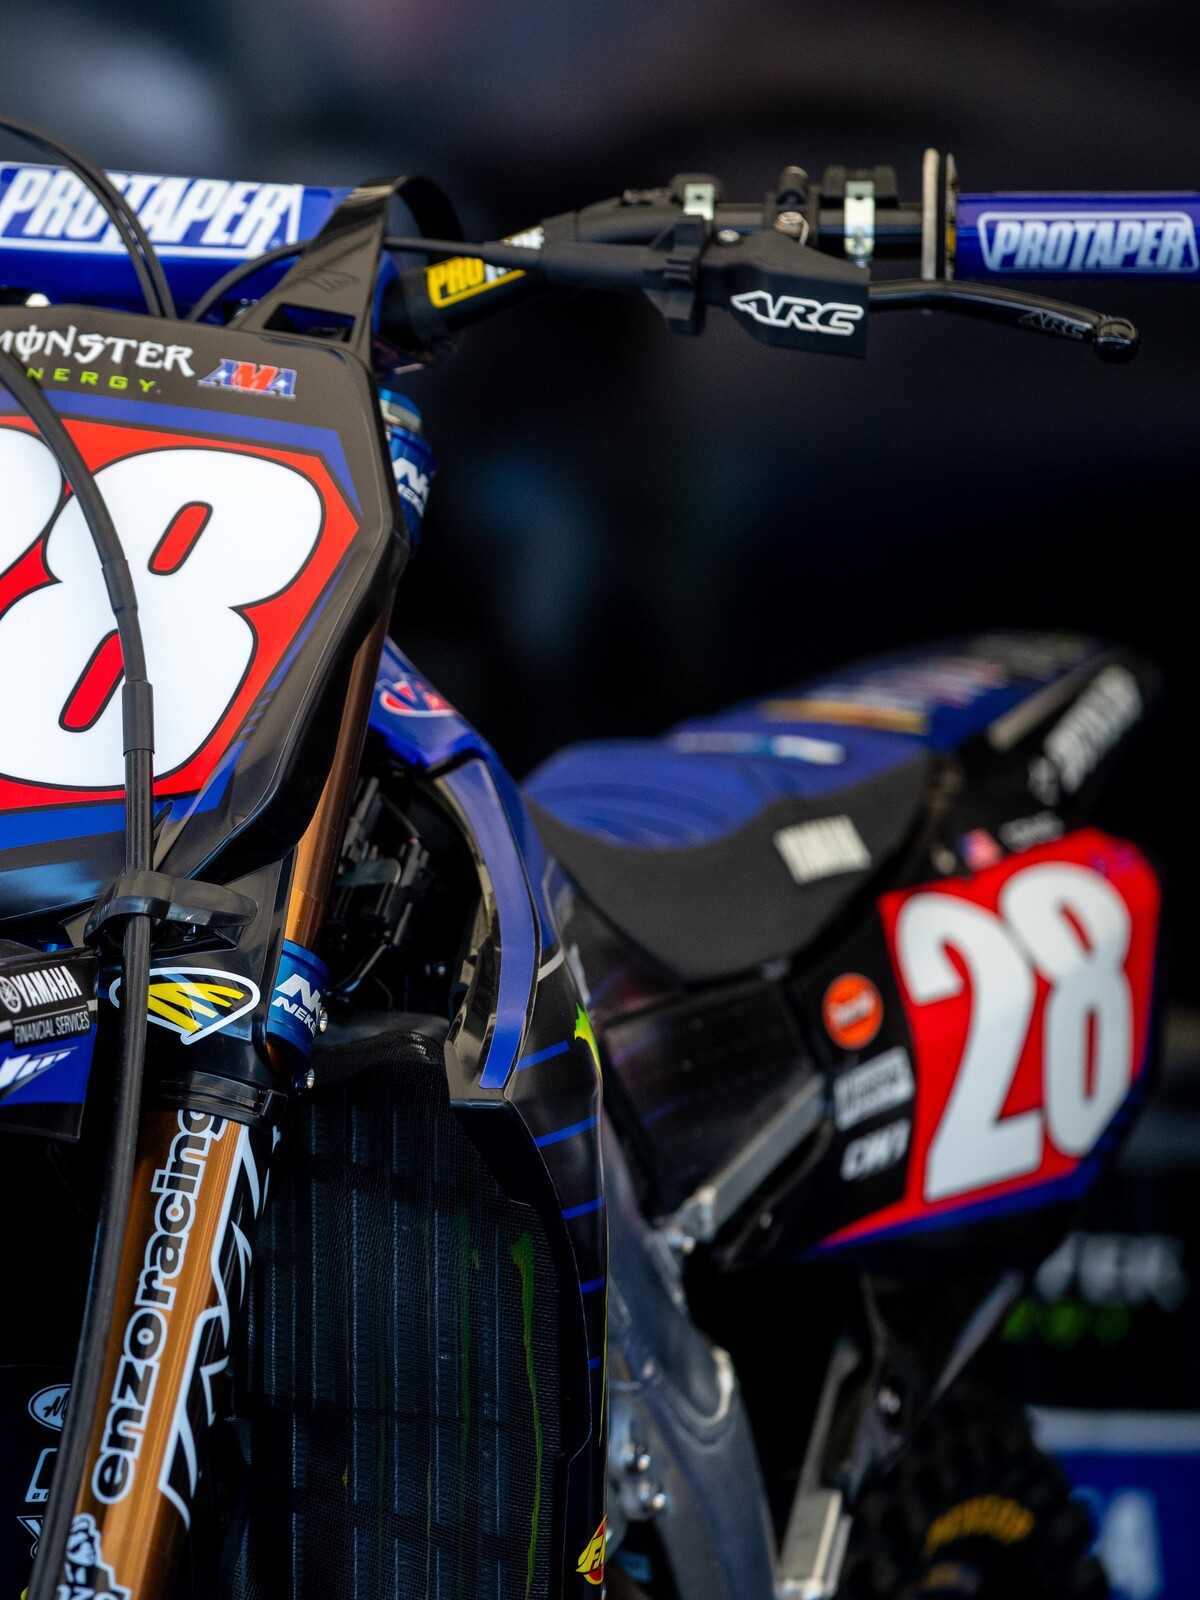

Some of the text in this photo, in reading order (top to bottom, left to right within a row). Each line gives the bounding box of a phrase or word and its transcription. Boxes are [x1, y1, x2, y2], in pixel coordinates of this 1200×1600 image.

[991, 219, 1190, 272] PROTAPER
[730, 289, 864, 337] ARC
[26, 366, 157, 393] NERGY
[198, 358, 297, 400] AMA
[10, 965, 83, 1008] YAMAHA
[14, 1010, 91, 1044] FINANCIAL SERVICES
[895, 860, 1134, 1203] 28
